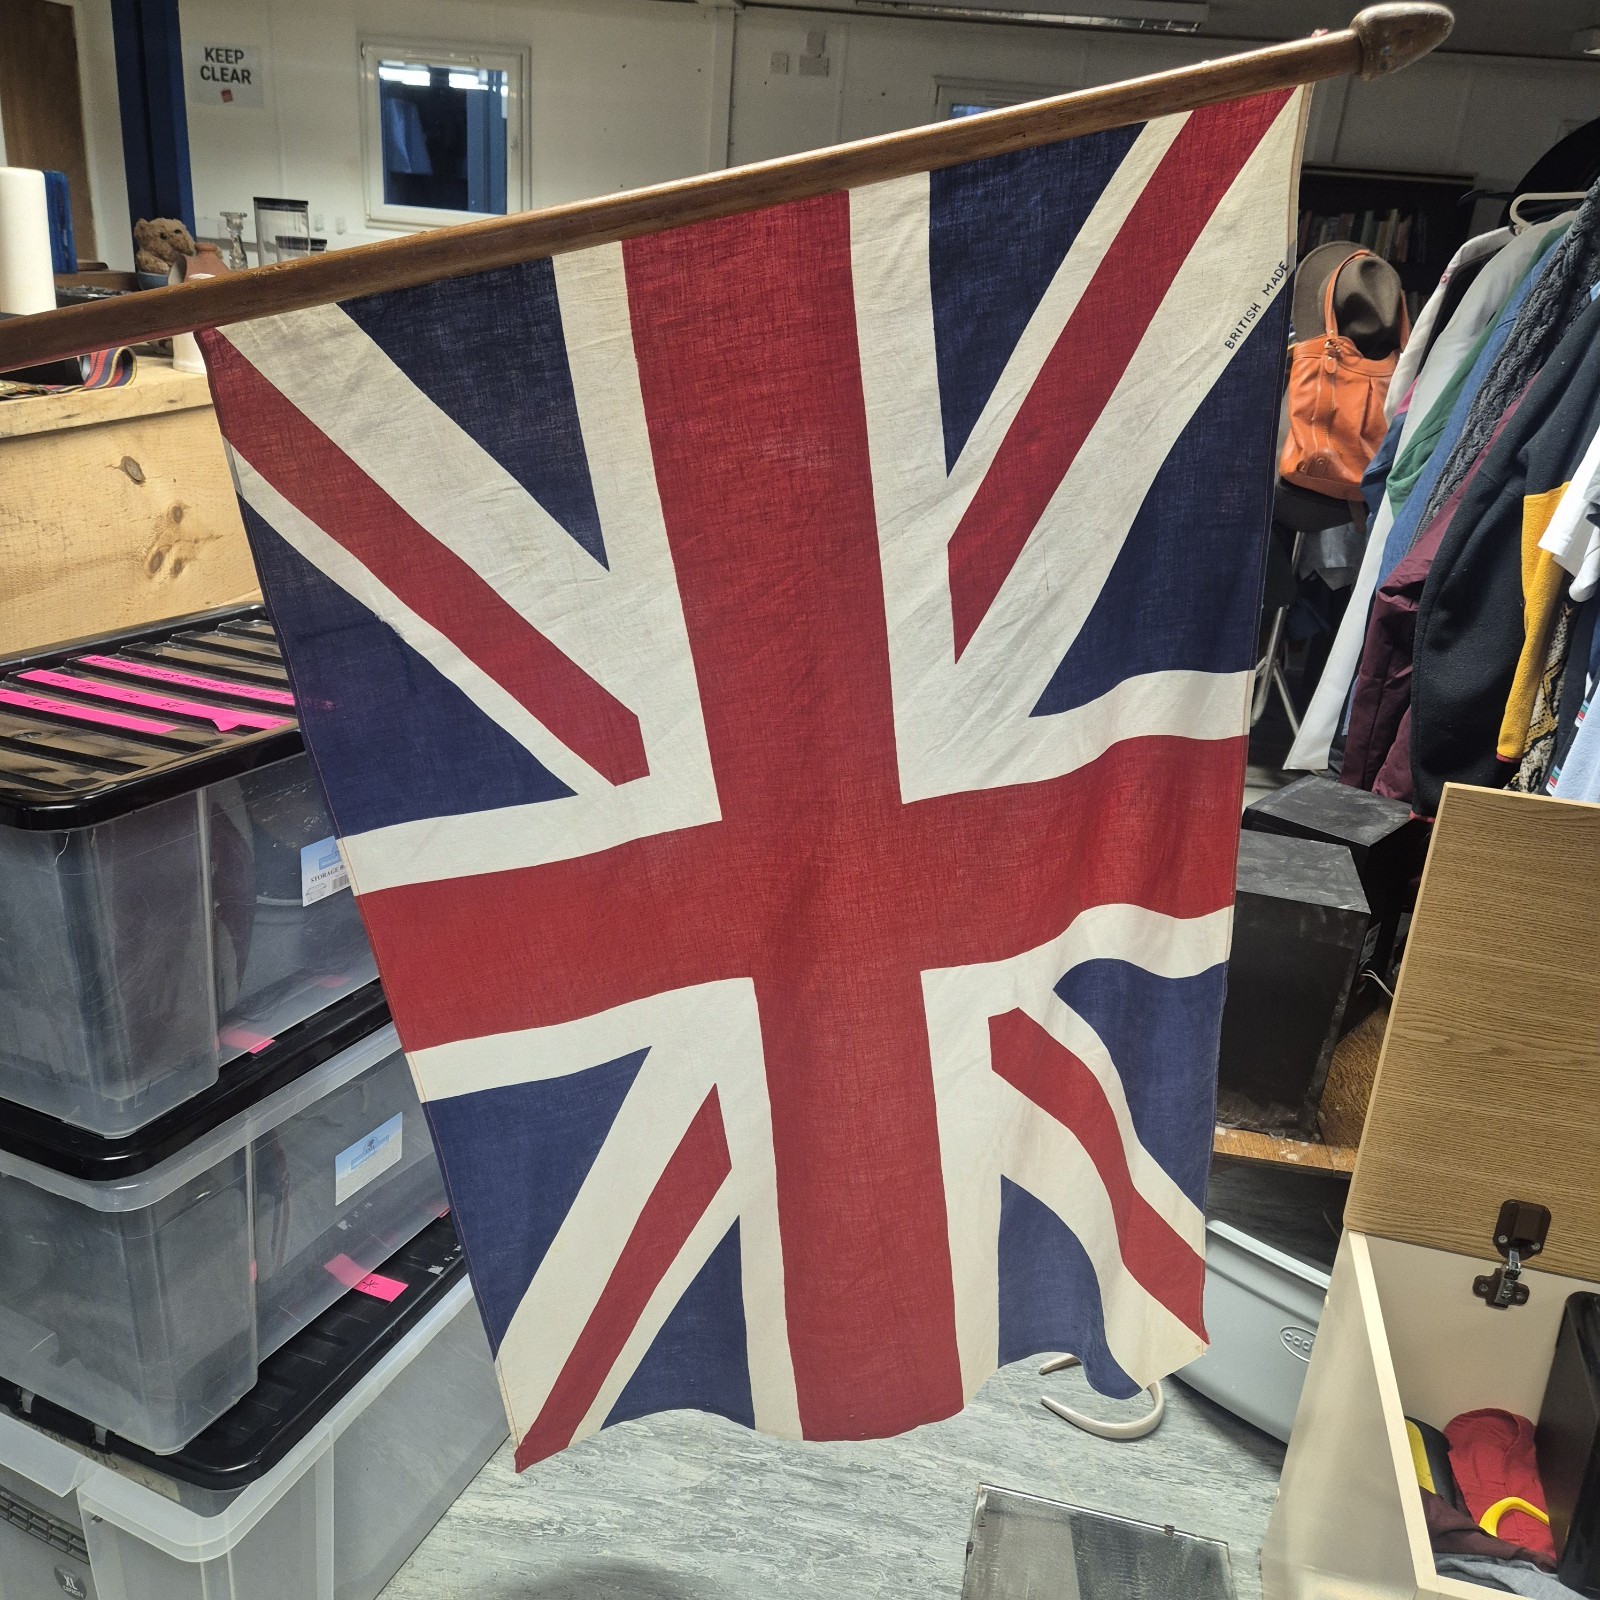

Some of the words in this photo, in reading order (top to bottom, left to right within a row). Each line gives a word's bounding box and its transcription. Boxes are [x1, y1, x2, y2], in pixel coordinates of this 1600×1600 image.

[204, 47, 244, 65] KEEP
[200, 65, 252, 85] CLEAR
[1224, 302, 1262, 350] BRITISH
[1261, 260, 1290, 296] MADE
[310, 866, 339, 883] STORAGE
[63, 1574, 78, 1590] XL
